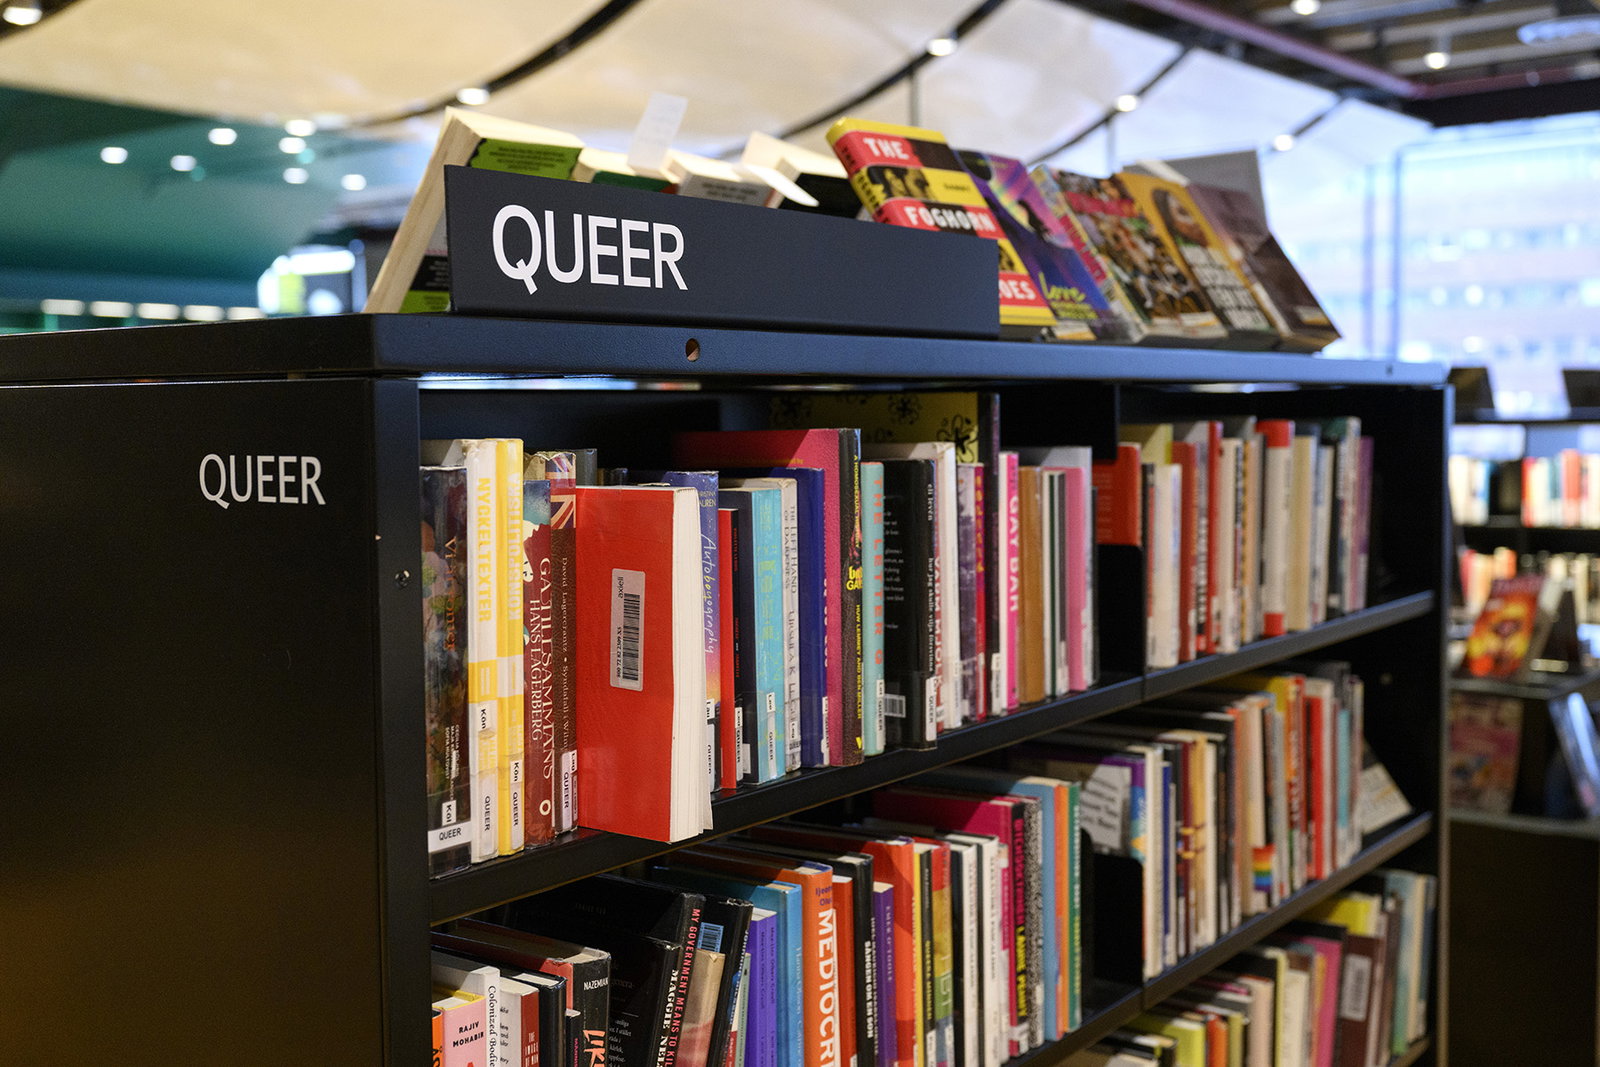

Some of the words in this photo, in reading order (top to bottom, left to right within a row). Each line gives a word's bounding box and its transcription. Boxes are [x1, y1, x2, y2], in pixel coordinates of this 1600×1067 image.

[863, 137, 910, 160] THE
[904, 206, 996, 233] FOGHORN
[492, 204, 689, 295] QUEER
[199, 453, 326, 510] QUEER
[873, 475, 883, 525] THE
[1009, 495, 1019, 550] GAY
[444, 536, 457, 559] Vi
[477, 477, 492, 622] NYCKELTEXTER
[790, 556, 798, 594] HAND
[874, 538, 883, 635] LETTER
[926, 574, 934, 587] jag
[1009, 556, 1019, 612] BAR
[700, 534, 717, 653] Autoboyography
[530, 600, 541, 643] HANS
[927, 615, 935, 632] vilja
[530, 648, 542, 741] LAGERBERG
[563, 772, 571, 809] QUEER
[439, 827, 462, 841] QUEER
[691, 908, 701, 923] MY
[678, 926, 698, 995] GOVERNMENT
[583, 976, 609, 991] NAZEMIAN
[662, 969, 679, 1029] MAGGIE
[865, 984, 873, 1001] OM
[487, 985, 499, 1037] Colonized
[671, 997, 685, 1033] MEANS
[865, 1001, 873, 1016] EN
[452, 1031, 484, 1048] MOHABIR
[458, 1021, 480, 1034] RAJIV
[528, 1031, 536, 1043] THE
[668, 1035, 678, 1047] TO
